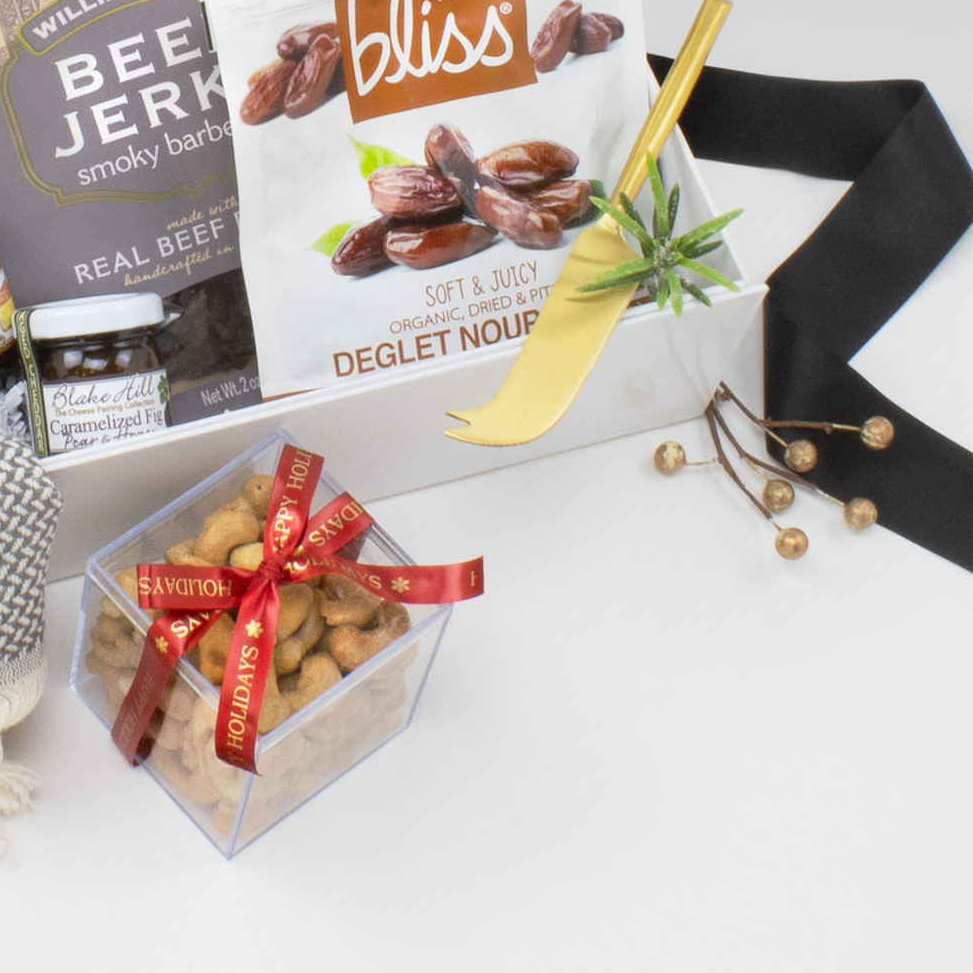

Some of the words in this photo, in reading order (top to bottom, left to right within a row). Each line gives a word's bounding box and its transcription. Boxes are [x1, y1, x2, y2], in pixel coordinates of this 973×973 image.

[54, 17, 216, 101] BEE
[77, 144, 159, 186] smoky
[166, 209, 204, 231] made
[209, 195, 239, 215] with
[73, 245, 151, 285] REAL
[156, 217, 225, 258] BEEF
[124, 249, 212, 287] handcrafted
[216, 241, 235, 257] in
[426, 278, 464, 307] SOFT
[472, 275, 486, 296] &
[490, 260, 538, 292] JUICY
[389, 307, 465, 334] ORGANIC,
[468, 295, 512, 317] DRIED
[515, 291, 527, 305] &
[529, 284, 554, 302] PIT
[333, 329, 451, 378] DEGLET
[19, 311, 31, 359] AGED
[28, 364, 45, 451] CHEDDAR
[52, 384, 111, 409] Blake
[114, 372, 156, 403] Hill
[200, 388, 223, 407] Net
[220, 380, 242, 400] Wt.
[239, 376, 250, 393] 2
[50, 410, 142, 437] Caramelized
[145, 409, 163, 425] Fig
[54, 409, 67, 417] The
[68, 405, 95, 416] Cheese
[97, 403, 123, 414] Pairing
[124, 398, 155, 409] Collection
[64, 432, 100, 449] Pear
[139, 577, 232, 597] HOLIDAYS
[228, 645, 259, 750] HOLIDAYS
